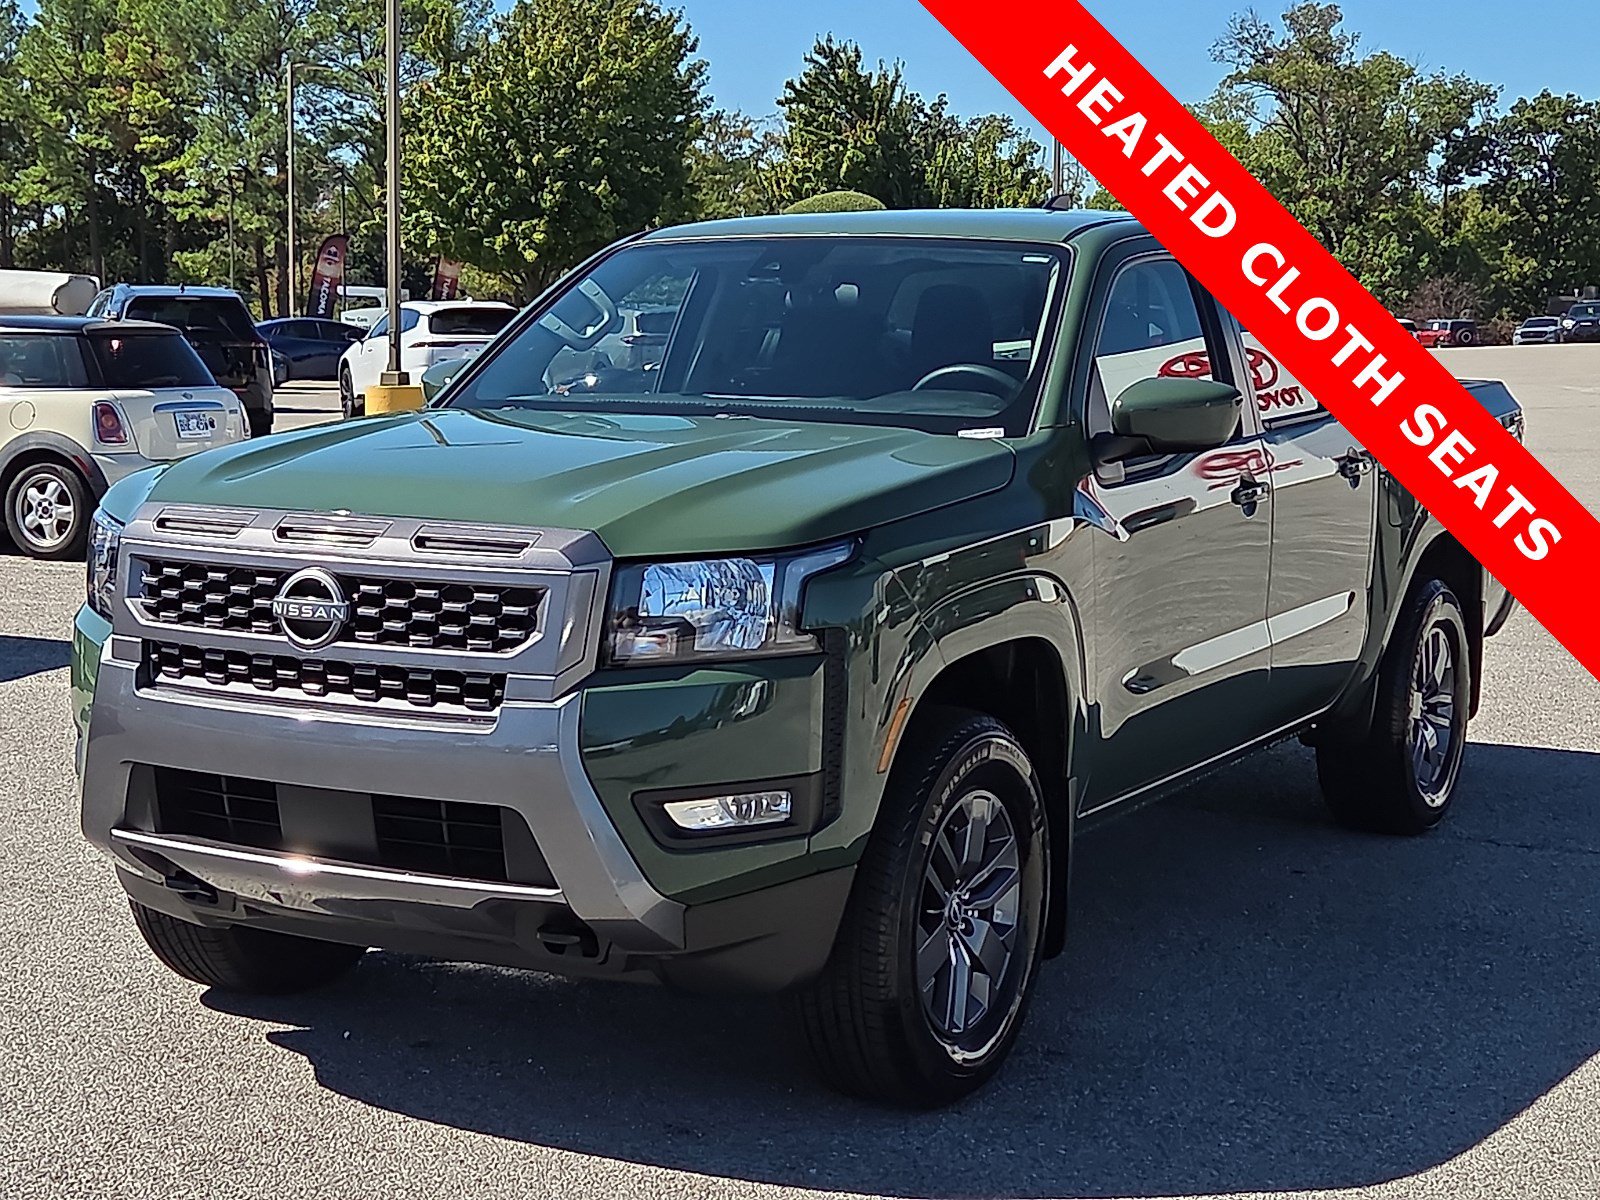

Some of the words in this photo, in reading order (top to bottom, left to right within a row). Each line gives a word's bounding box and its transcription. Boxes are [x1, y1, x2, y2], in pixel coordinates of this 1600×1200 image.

[317, 276, 332, 315] TACOMA
[440, 278, 452, 300] TUN
[272, 601, 345, 620] NISSAN
